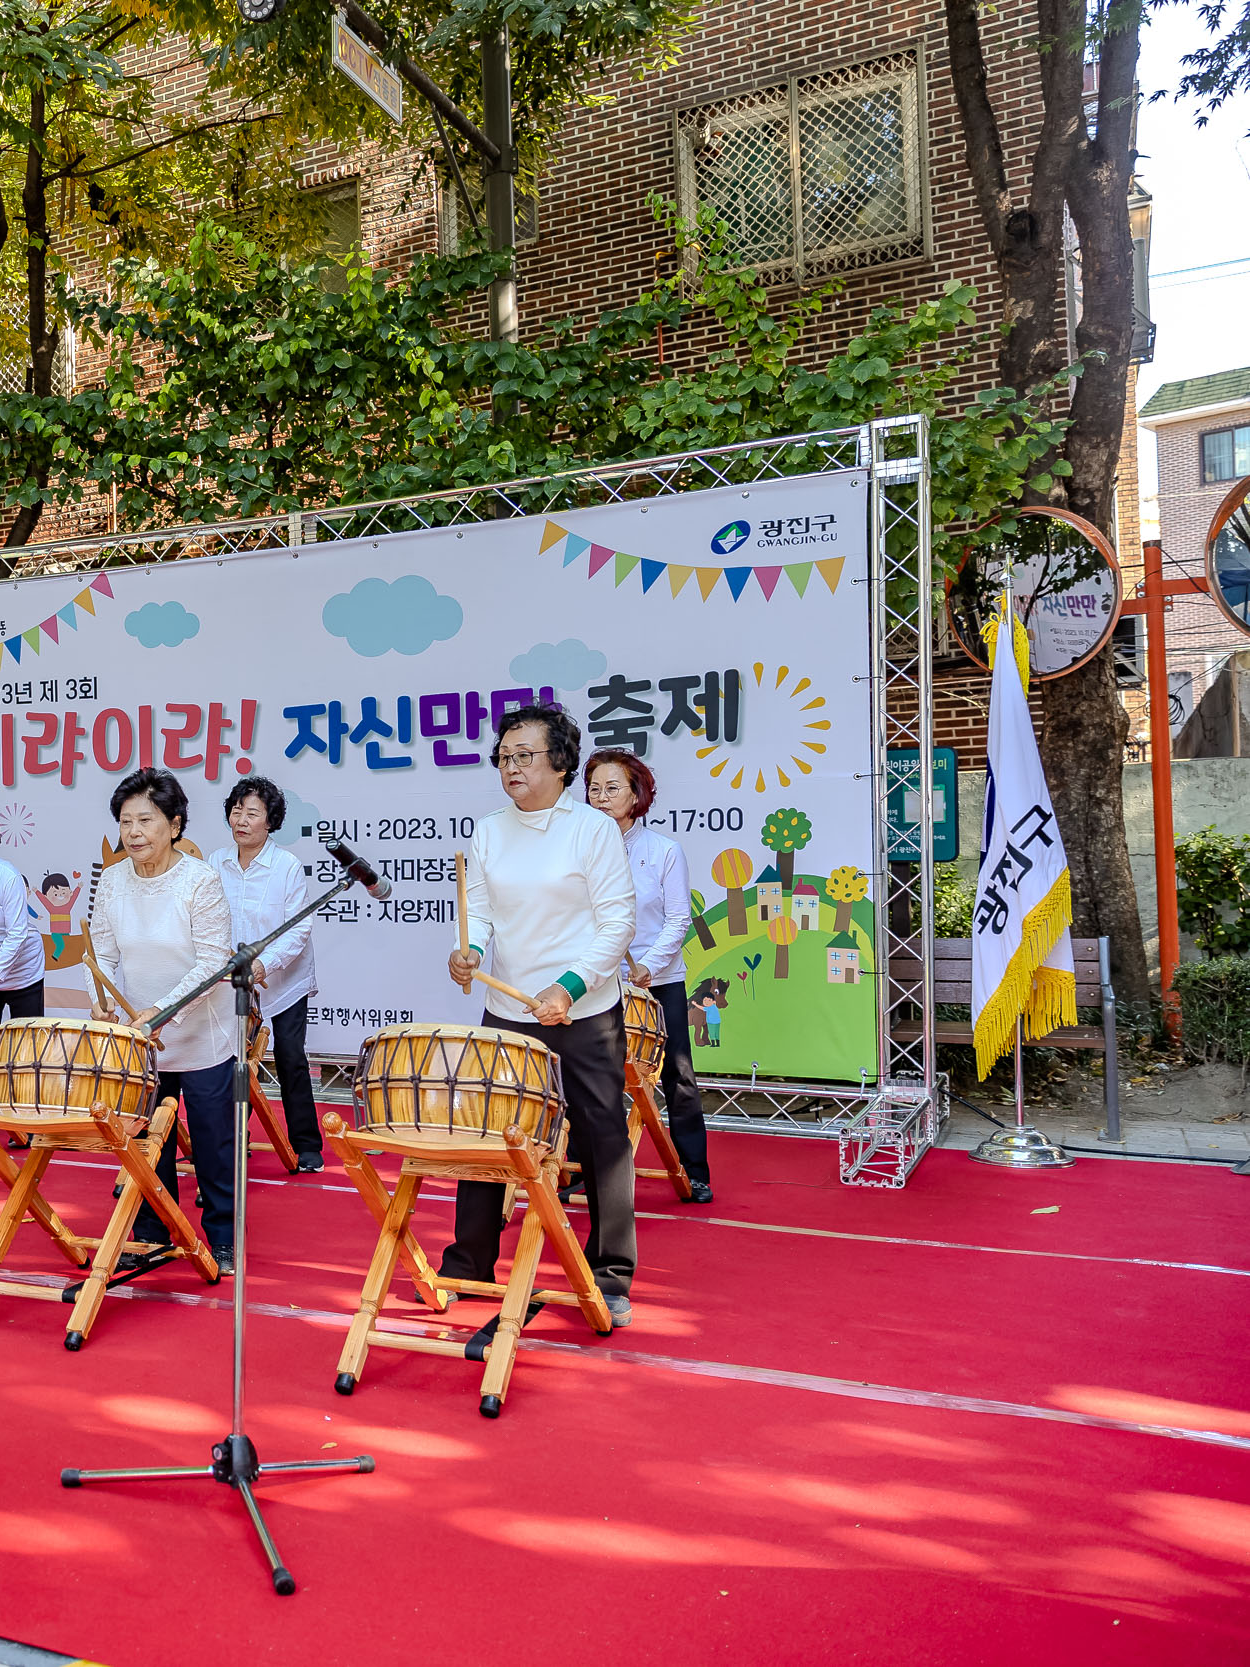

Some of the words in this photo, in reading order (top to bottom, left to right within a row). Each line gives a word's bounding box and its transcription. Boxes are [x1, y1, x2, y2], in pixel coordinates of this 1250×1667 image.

[758, 514, 838, 538] 광진구
[757, 532, 838, 548] GWANGJIN-GU
[39, 679, 58, 702] 제
[65, 676, 98, 700] 3회
[587, 669, 741, 757] 축제
[316, 819, 358, 843] 일시
[378, 818, 443, 840] 2023.
[973, 804, 1055, 936] 광진구
[316, 899, 360, 923] 주관
